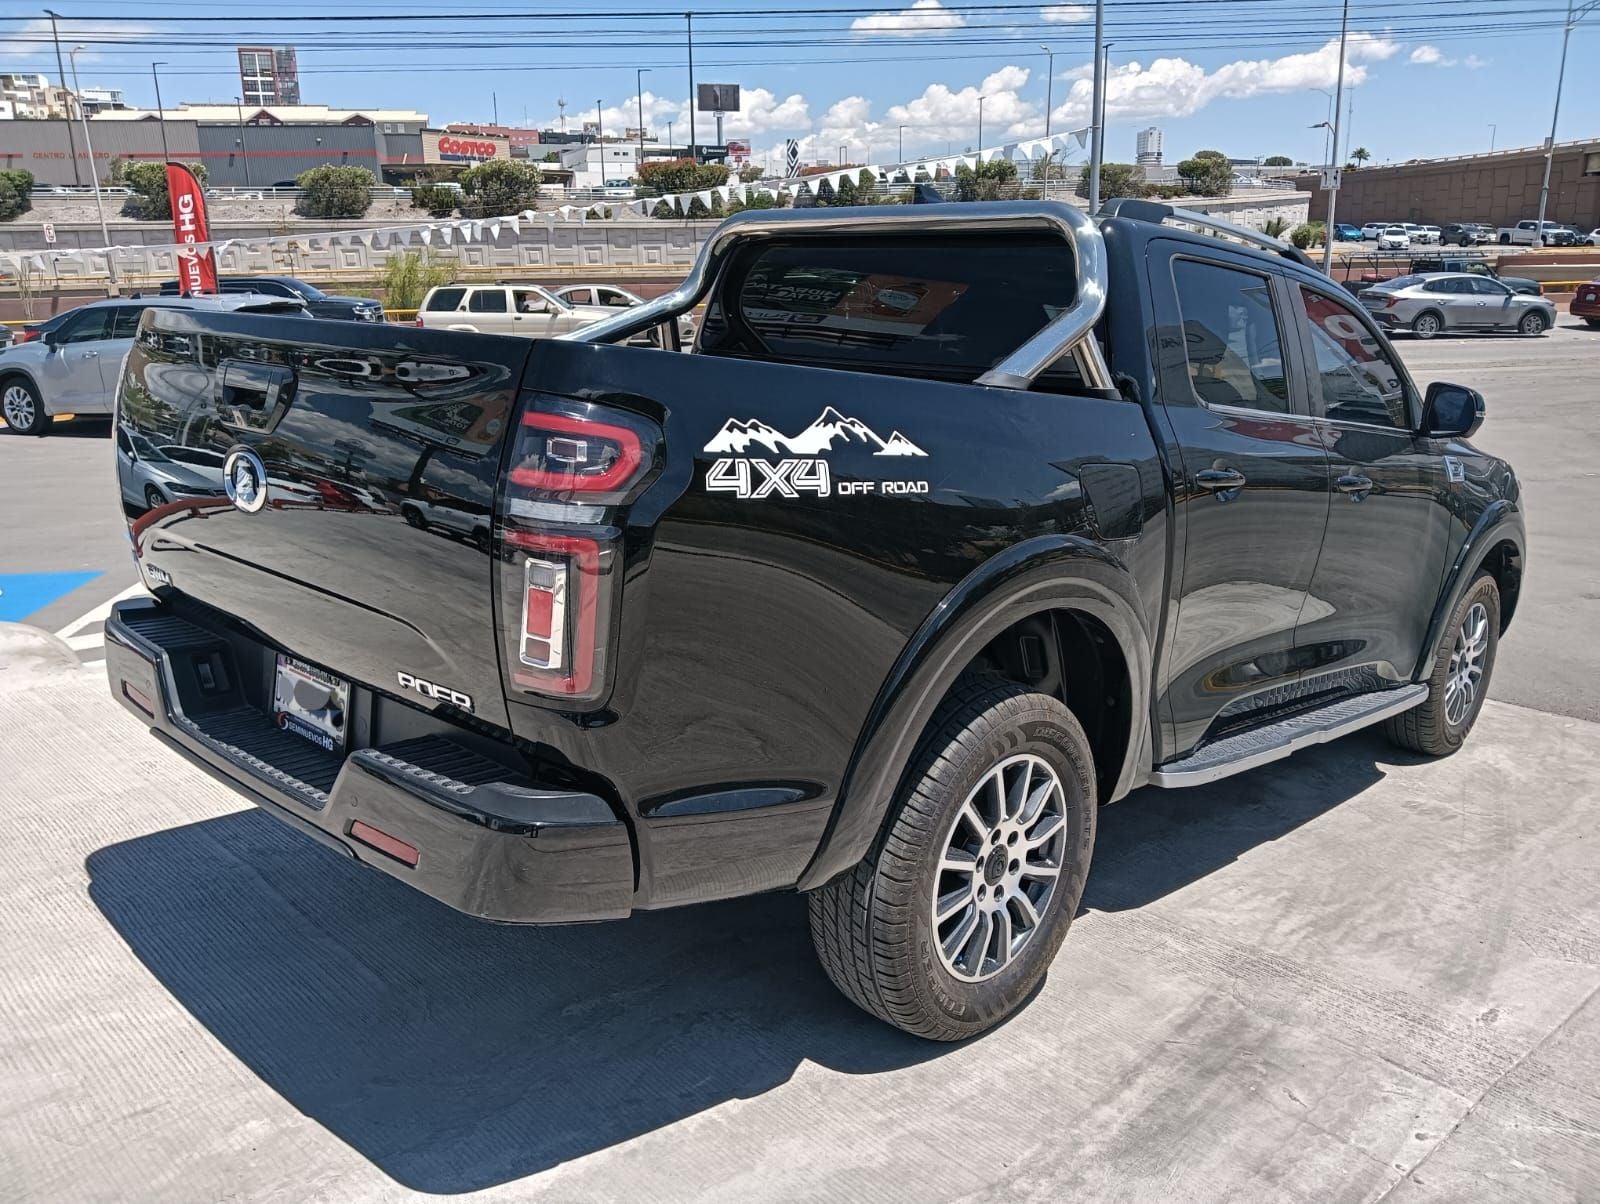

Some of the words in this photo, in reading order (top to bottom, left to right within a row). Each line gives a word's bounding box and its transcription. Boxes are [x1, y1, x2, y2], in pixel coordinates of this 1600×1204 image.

[438, 137, 496, 156] COSTCO
[179, 194, 196, 231] HG
[838, 482, 875, 495] OFF
[882, 481, 929, 494] ROAD
[288, 721, 322, 745] SEMINUEVOS
[321, 735, 334, 751] HG
